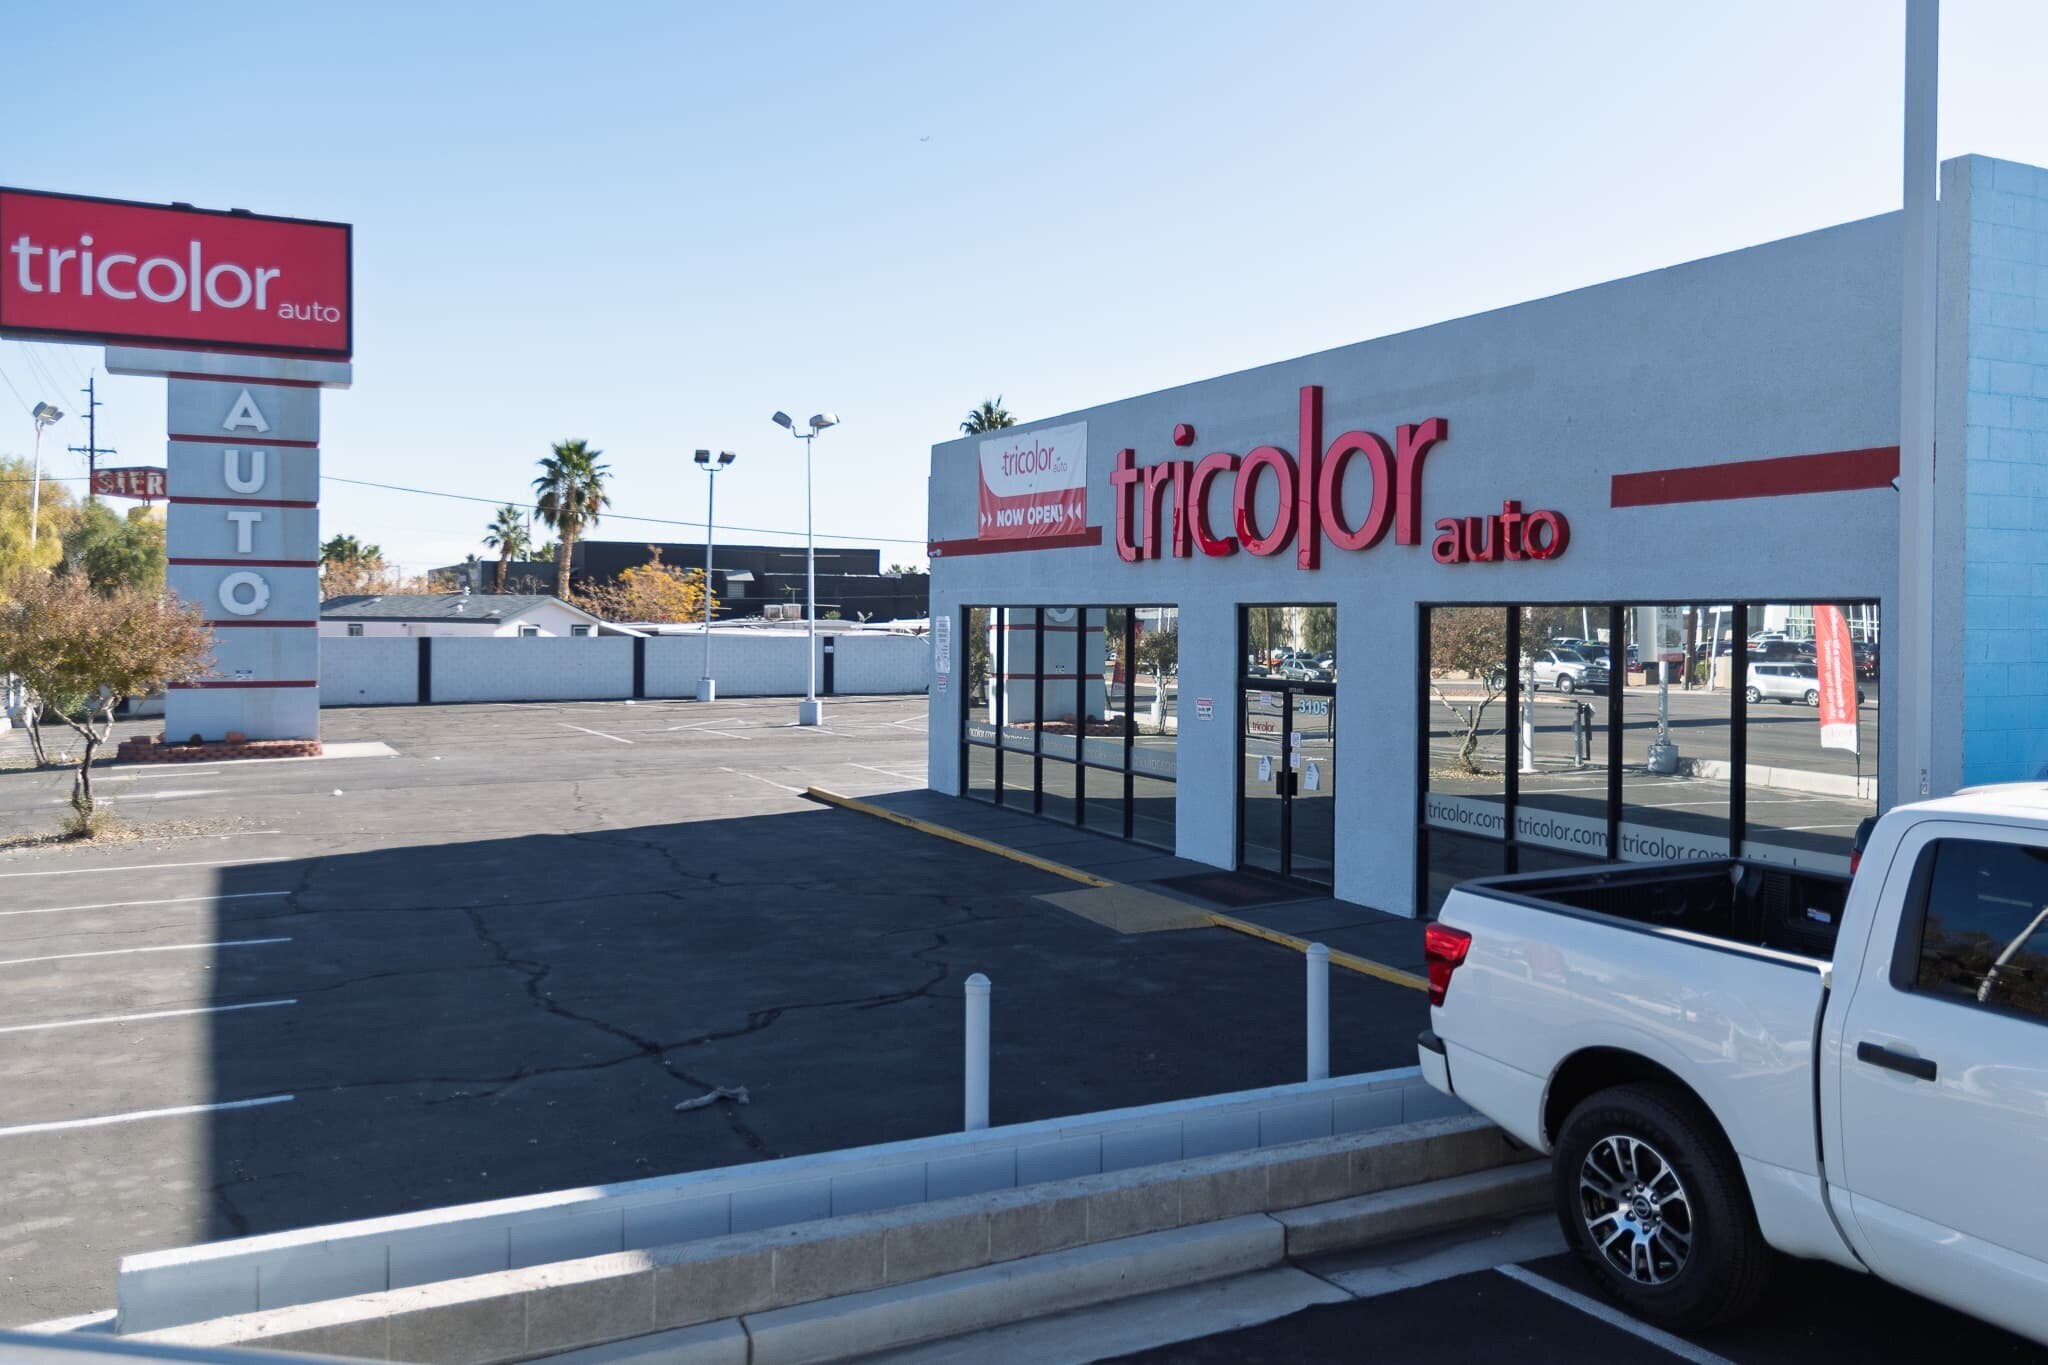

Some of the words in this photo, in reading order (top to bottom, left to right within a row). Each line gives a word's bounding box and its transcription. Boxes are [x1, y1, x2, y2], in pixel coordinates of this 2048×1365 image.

[11, 234, 281, 313] tricolor
[278, 302, 340, 323] auto
[1003, 440, 1055, 477] tricolor
[1053, 461, 1068, 473] auto
[1110, 385, 1448, 570] tricolor
[996, 508, 1025, 528] NOW
[1027, 503, 1063, 525] OPEN!
[1432, 500, 1570, 564] auto
[1299, 699, 1328, 716] 3105
[1428, 801, 1505, 830] tricolor.com
[1518, 816, 1608, 848] tricolor.com
